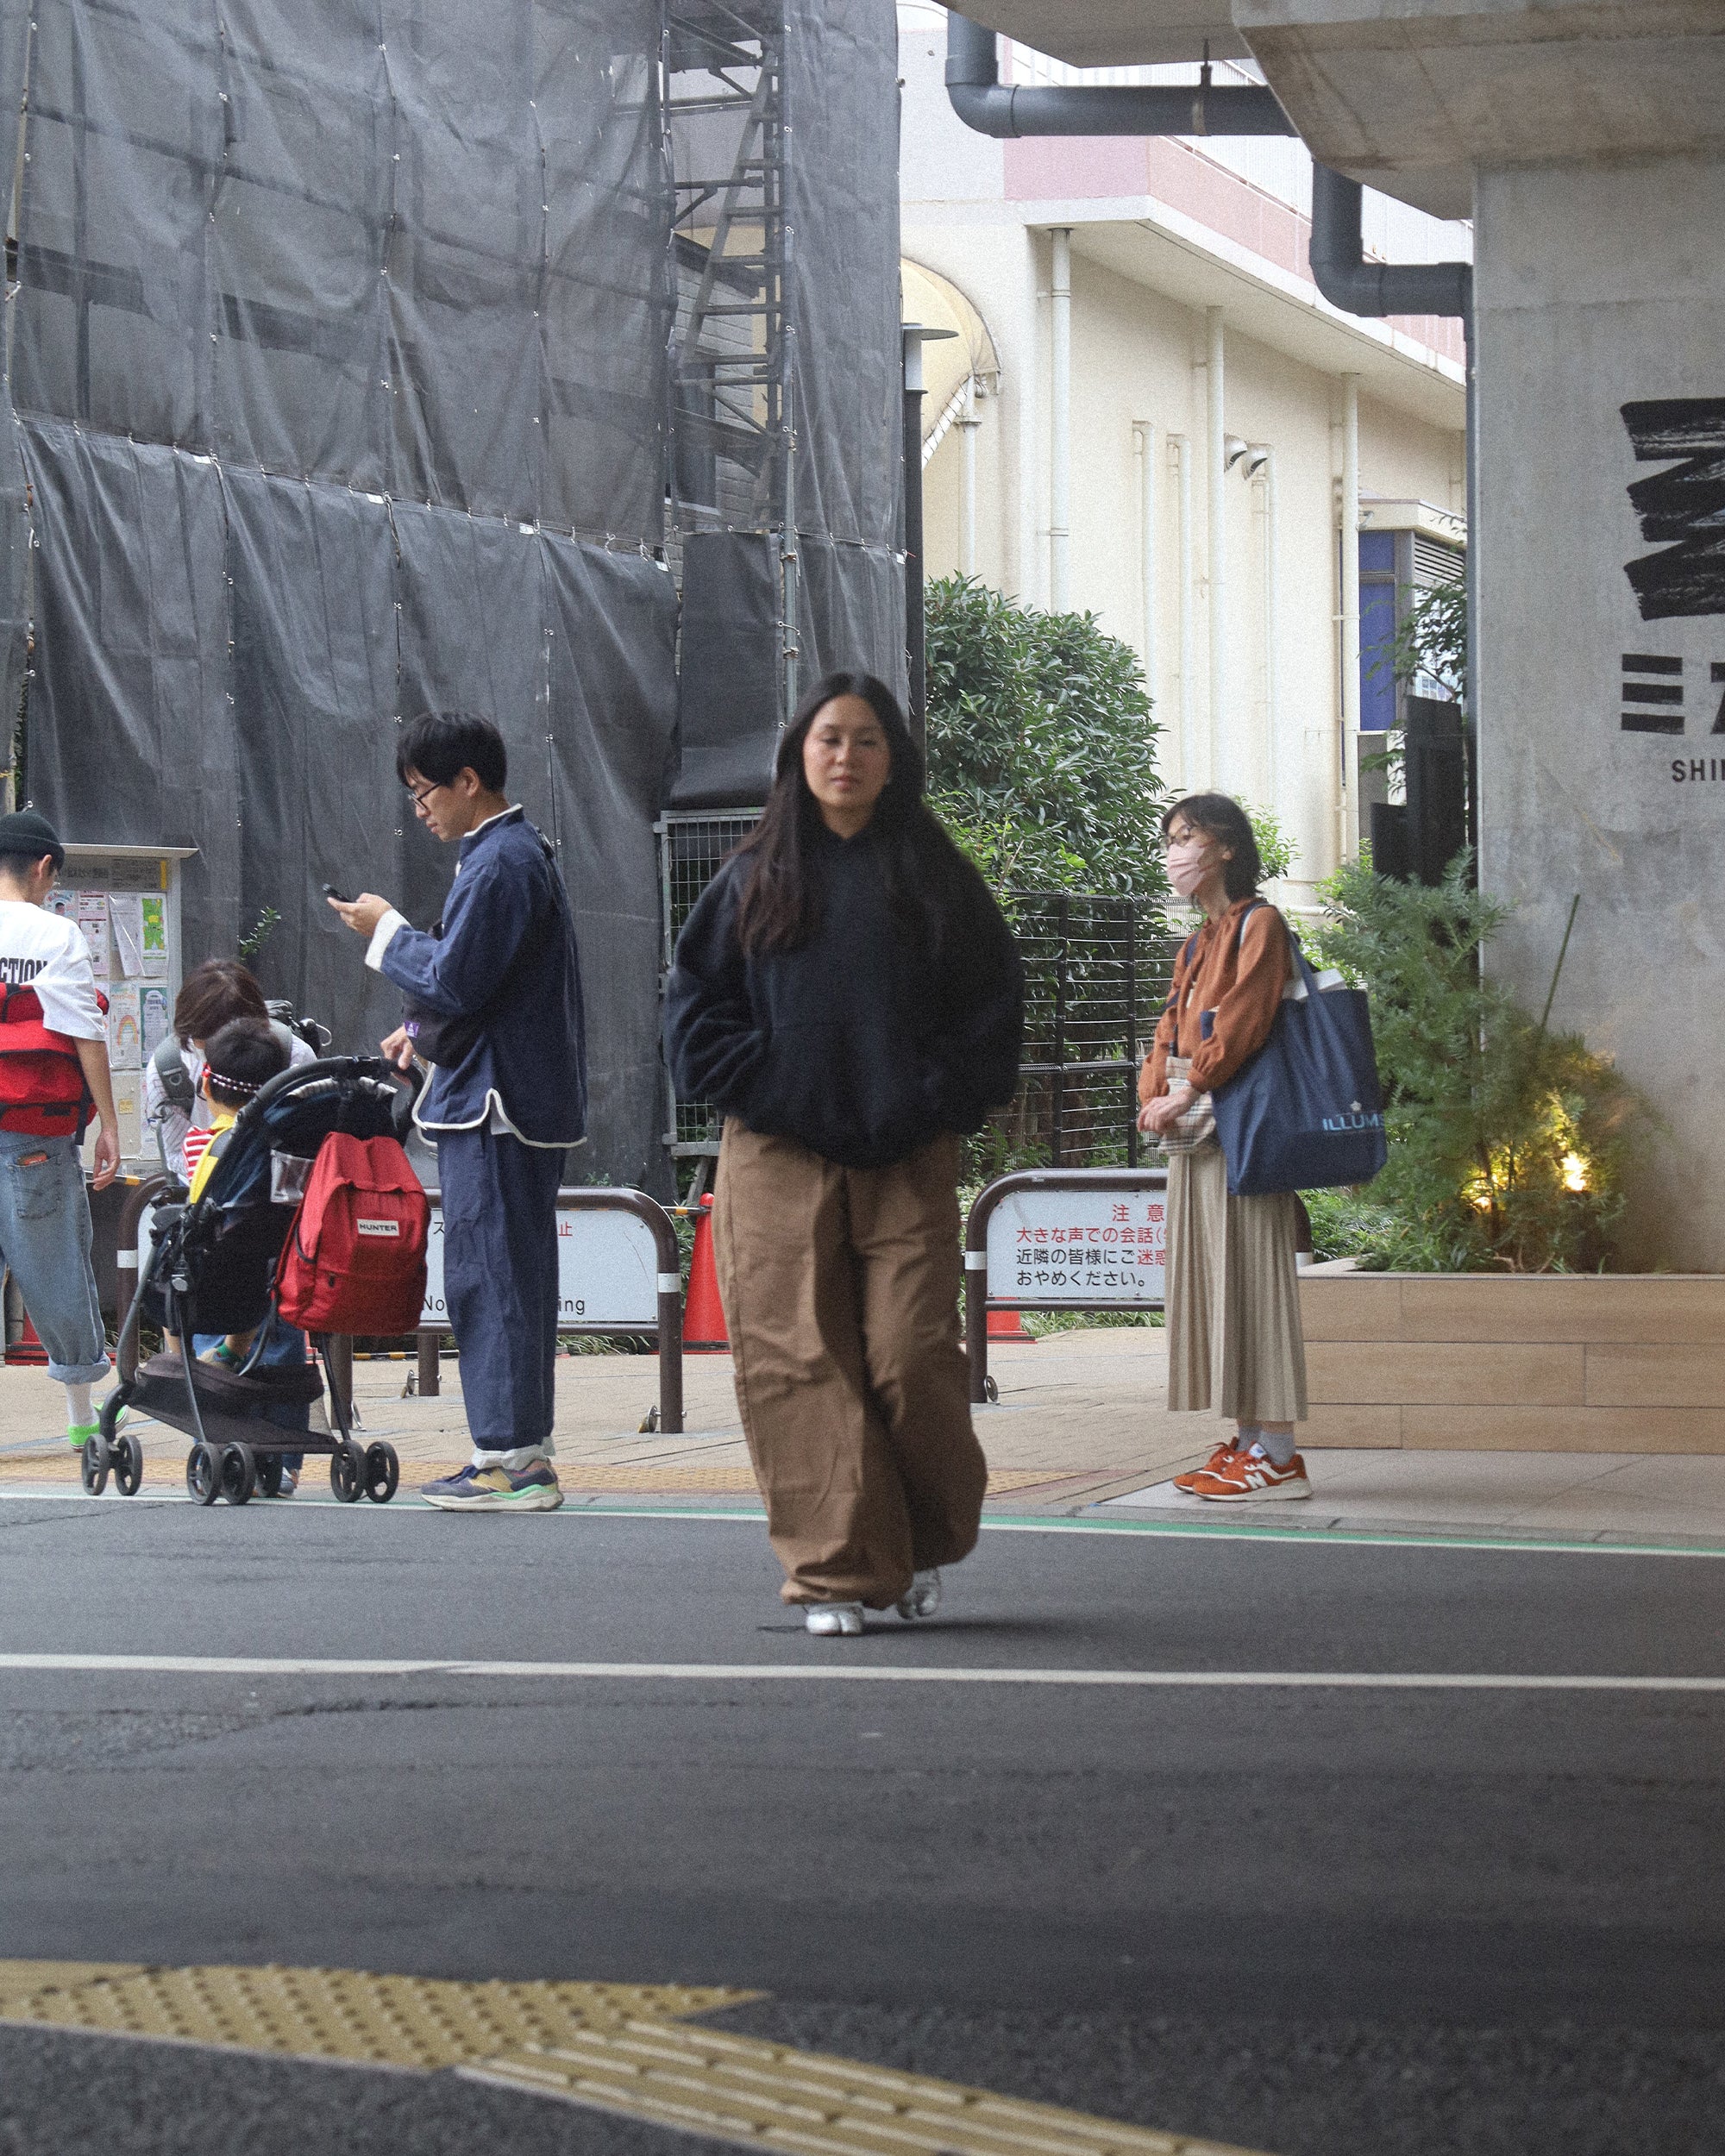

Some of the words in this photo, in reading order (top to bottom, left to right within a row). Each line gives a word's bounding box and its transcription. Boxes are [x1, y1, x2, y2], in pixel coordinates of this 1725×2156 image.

[1672, 758, 1725, 782] SHI
[359, 1223, 398, 1232] HUNTER
[1016, 1226, 1166, 1244] 大きな声での会話(
[1017, 1269, 1145, 1287] おやめください。
